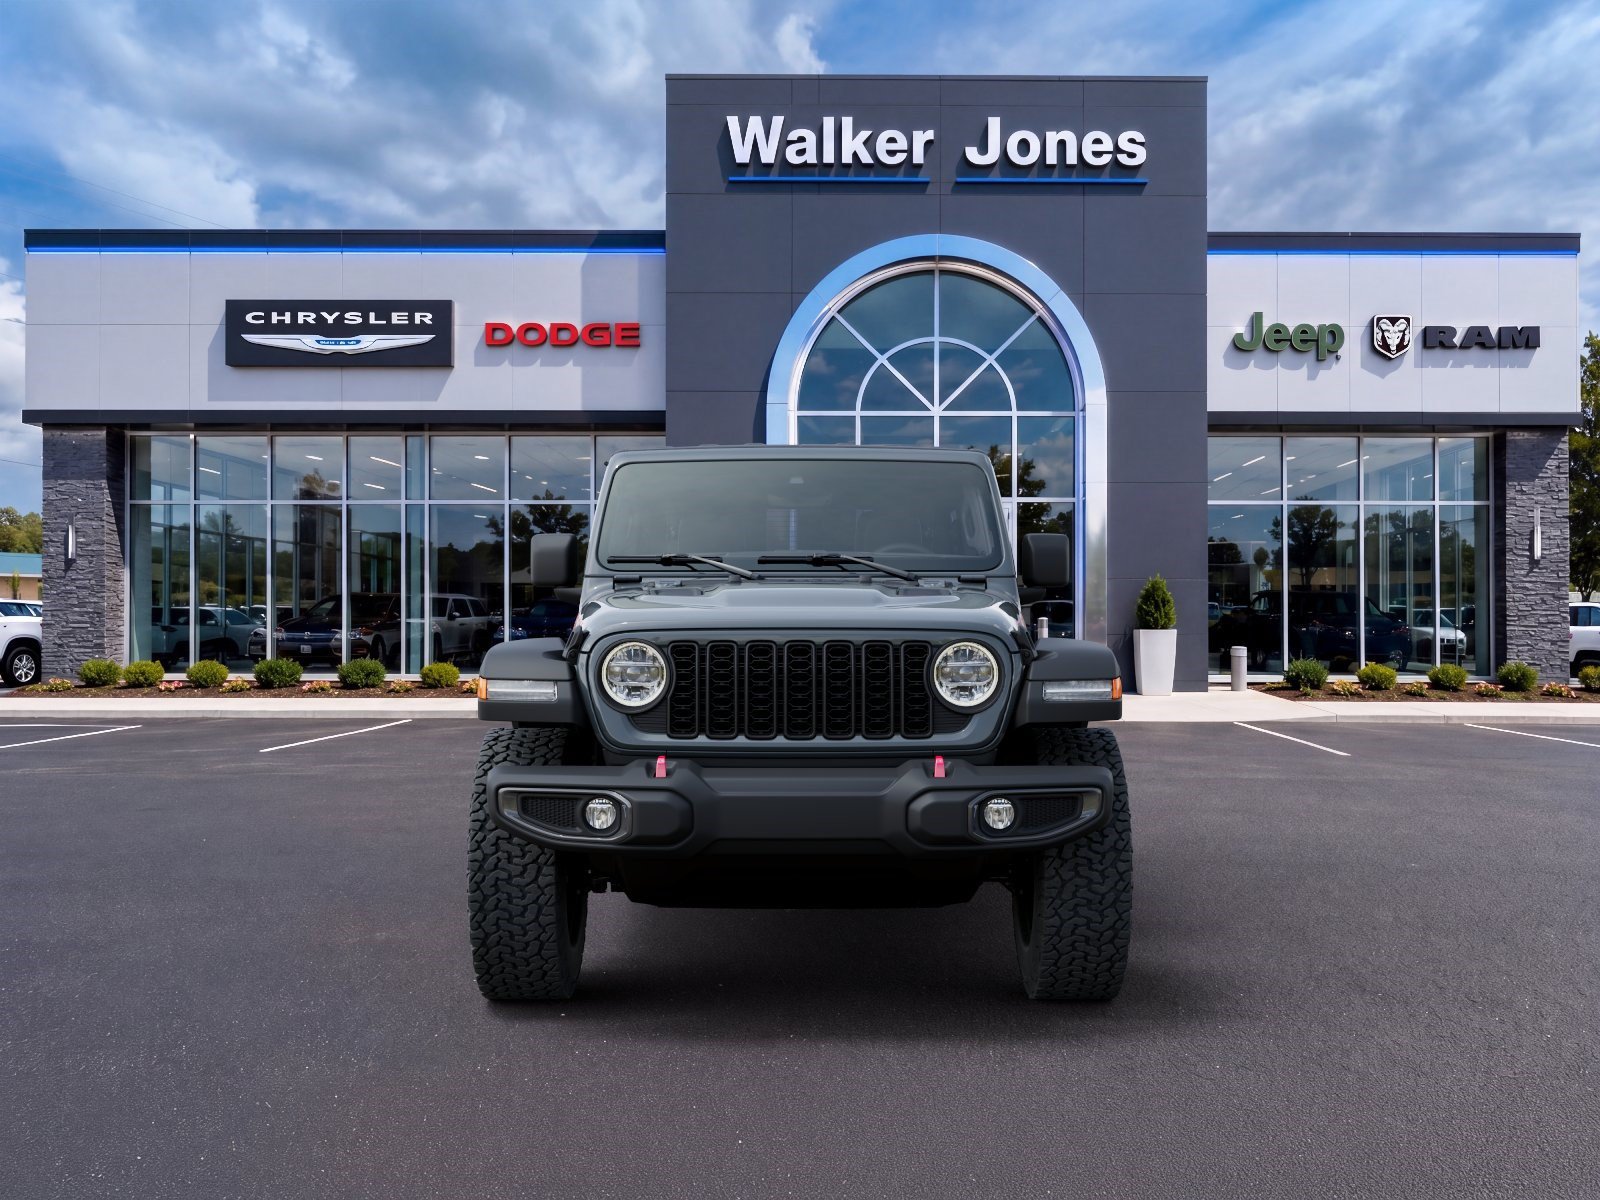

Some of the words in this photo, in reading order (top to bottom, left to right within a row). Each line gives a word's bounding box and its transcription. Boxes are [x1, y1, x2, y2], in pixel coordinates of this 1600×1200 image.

[726, 115, 934, 166] Walker
[965, 116, 1147, 166] Jones
[245, 311, 434, 325] CHRYSLER
[485, 322, 641, 348] DODGE
[1233, 311, 1345, 361] Jeep
[1423, 325, 1541, 348] RAM
